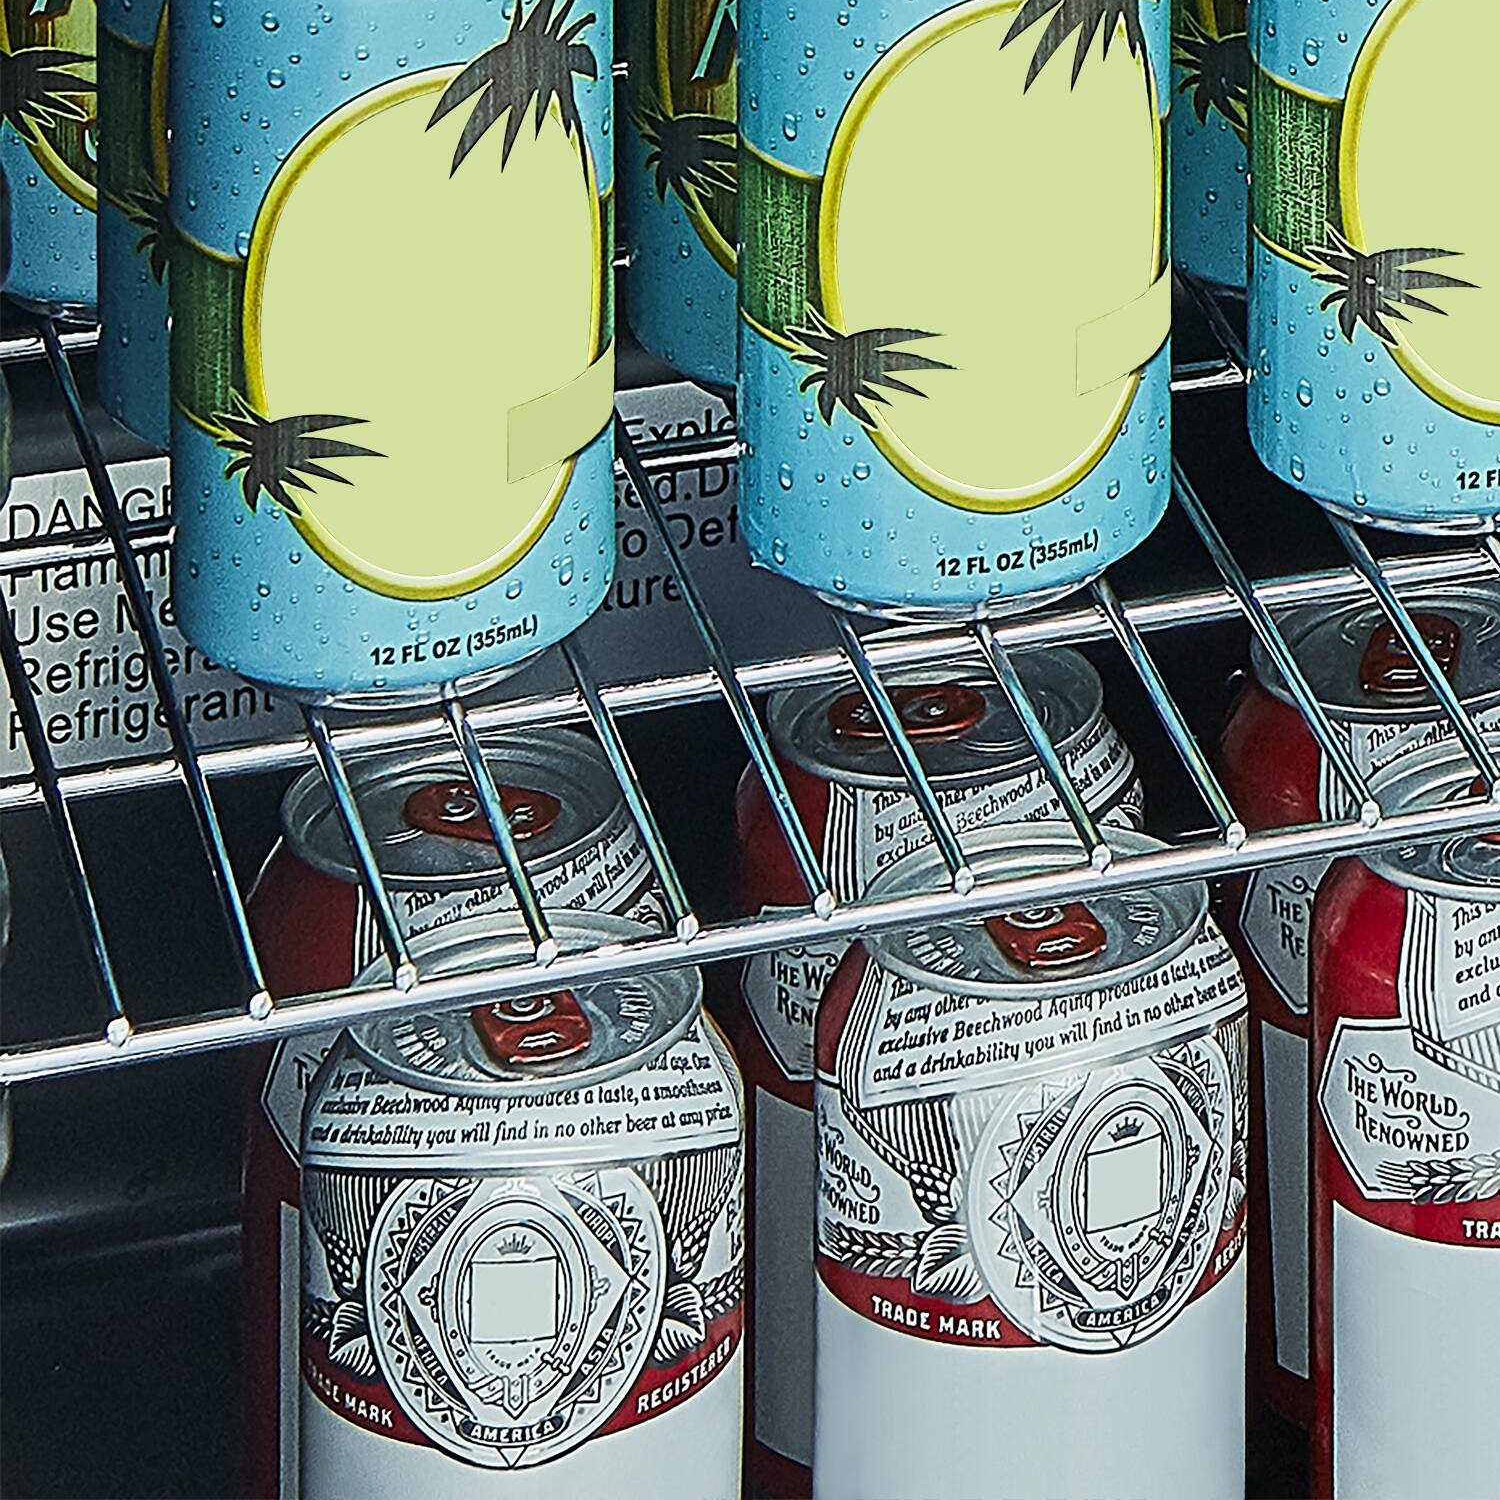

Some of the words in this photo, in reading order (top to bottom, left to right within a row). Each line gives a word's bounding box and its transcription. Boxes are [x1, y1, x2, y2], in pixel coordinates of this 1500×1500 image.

[1456, 471, 1480, 490] 12
[935, 558, 960, 577] 12
[966, 556, 990, 575] FL
[997, 550, 1025, 571] OZ
[1029, 527, 1098, 570] (355mL)
[11, 605, 100, 647] Use
[370, 647, 395, 666] 12
[401, 643, 427, 663] FL
[432, 637, 461, 658] OZ
[466, 613, 538, 656] (355mL)
[1266, 884, 1303, 923] THE
[1452, 902, 1481, 931] This
[1454, 940, 1473, 959] by
[1458, 984, 1491, 1011] and
[953, 1000, 1043, 1041] Beechwood
[873, 1059, 904, 1083] and
[905, 1061, 917, 1078] a
[920, 1041, 1020, 1075] drinkability
[1025, 1035, 1055, 1058] you
[1060, 1019, 1088, 1045] will
[1092, 1011, 1122, 1041] find
[1126, 1008, 1140, 1028] in
[1144, 1005, 1162, 1023] no
[584, 1088, 594, 1105] a
[641, 1086, 650, 1100] a
[1343, 1059, 1378, 1103] THE
[1380, 1077, 1463, 1122] WORLD
[426, 1127, 456, 1148] you
[461, 1122, 490, 1144] will
[493, 1120, 528, 1145] find
[533, 1120, 548, 1139] in
[554, 1120, 576, 1138] no
[580, 1115, 622, 1137] other
[626, 1113, 658, 1133] beer
[661, 1111, 676, 1128] at
[1025, 1105, 1071, 1169] AUSTRALIA
[1355, 1100, 1469, 1153] RENOWNED
[872, 1296, 931, 1329] TRADE
[939, 1315, 1001, 1339] MARK
[1086, 1296, 1160, 1327] AMERICA
[581, 1327, 615, 1376] ASIA
[635, 1335, 731, 1412] REGISTERED
[471, 1421, 556, 1443] AMERICA
